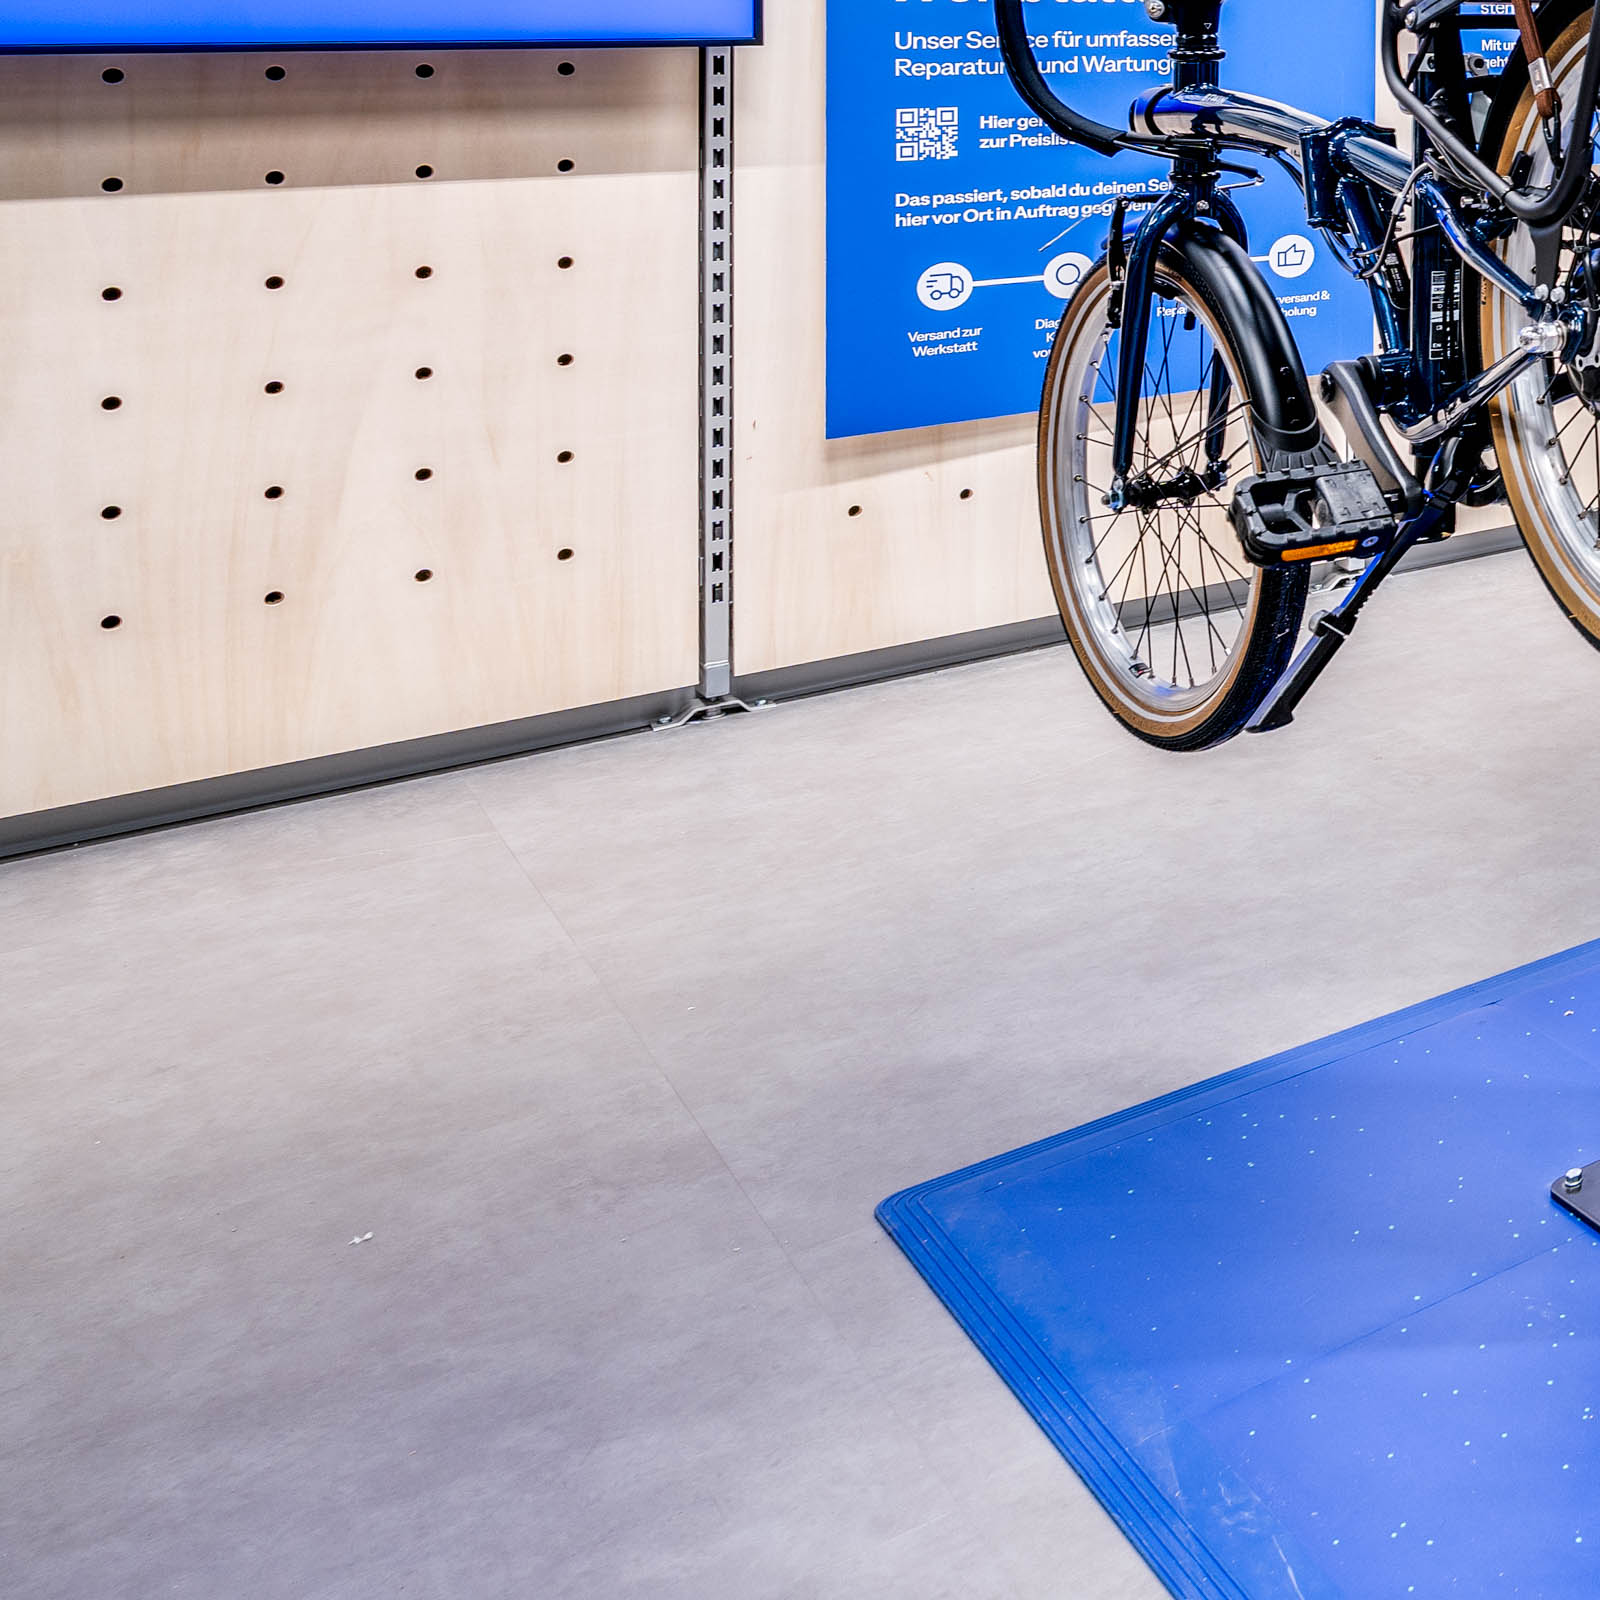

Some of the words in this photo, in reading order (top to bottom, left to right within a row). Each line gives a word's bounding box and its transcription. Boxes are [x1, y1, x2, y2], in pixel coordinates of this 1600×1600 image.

[895, 32, 963, 50] Unser
[1052, 30, 1081, 48] für
[895, 58, 1005, 80] Reparatur
[1039, 56, 1078, 74] und
[979, 115, 1014, 130] Hier
[979, 136, 1006, 149] zur
[895, 193, 930, 208] Das
[933, 189, 1008, 209] passiert,
[1010, 185, 1066, 200] sobald
[1068, 183, 1090, 197] du
[1092, 181, 1146, 196] deinen
[895, 212, 930, 227] hier
[932, 212, 961, 224] vor
[963, 208, 994, 223] Ort
[996, 206, 1012, 221] in
[1014, 203, 1079, 222] Auftrag
[1320, 290, 1331, 301] &
[907, 328, 960, 343] Versand
[962, 326, 983, 338] zur
[912, 341, 978, 357] Werkstatt
